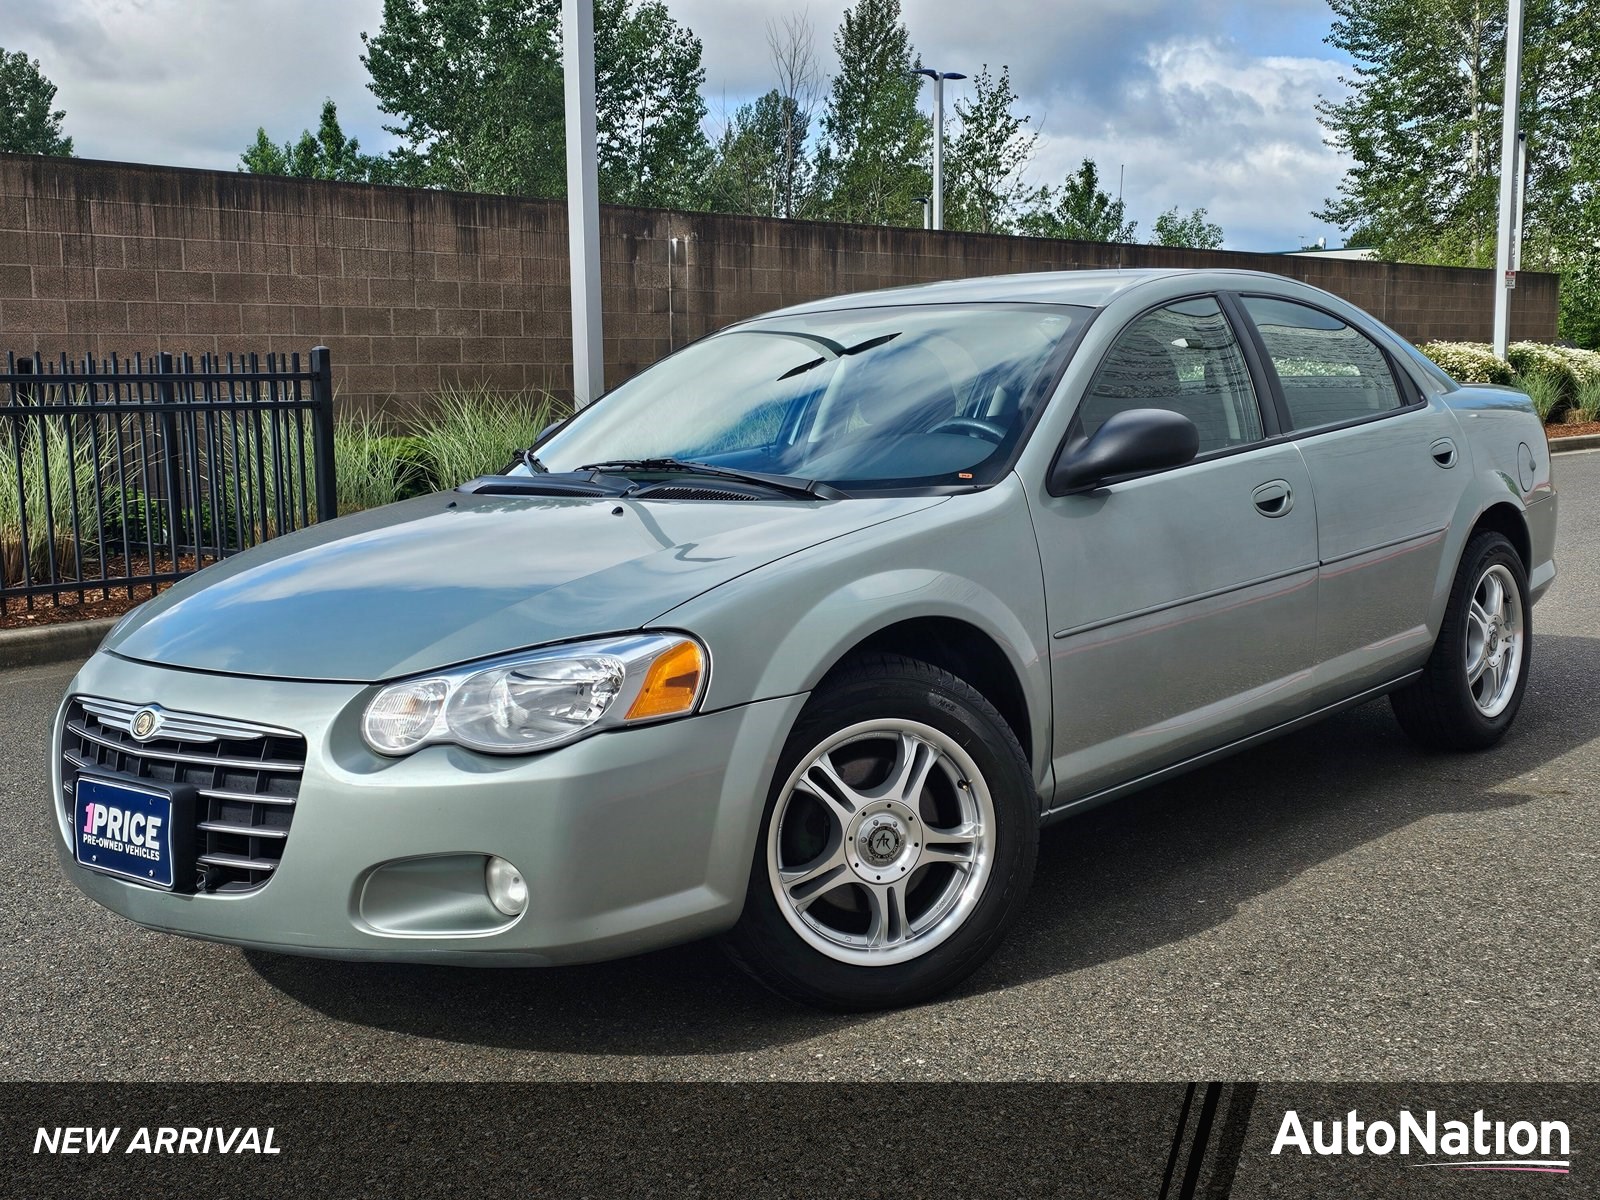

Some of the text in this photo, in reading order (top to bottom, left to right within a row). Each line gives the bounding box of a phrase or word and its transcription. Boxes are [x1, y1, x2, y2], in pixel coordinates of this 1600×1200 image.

[84, 803, 161, 850] 1PRICE
[83, 833, 160, 861] PRE-OWNED VEHICLES
